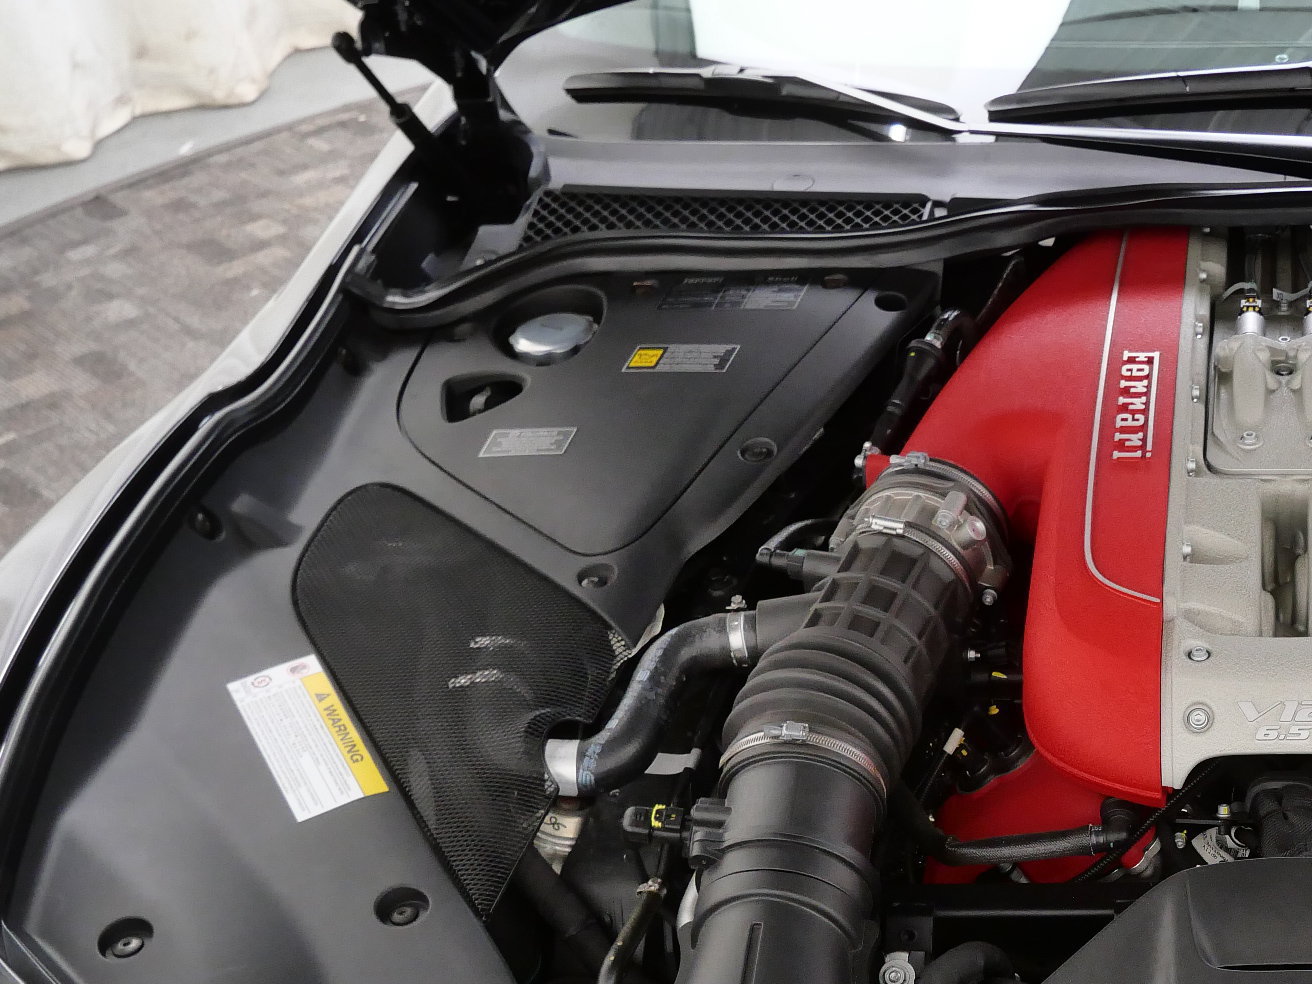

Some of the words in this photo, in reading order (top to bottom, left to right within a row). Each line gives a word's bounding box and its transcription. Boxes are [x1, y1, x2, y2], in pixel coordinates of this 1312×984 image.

[1112, 350, 1160, 460] Ferrari
[323, 704, 364, 764] WARNING
[1255, 725, 1312, 741] 6.5
